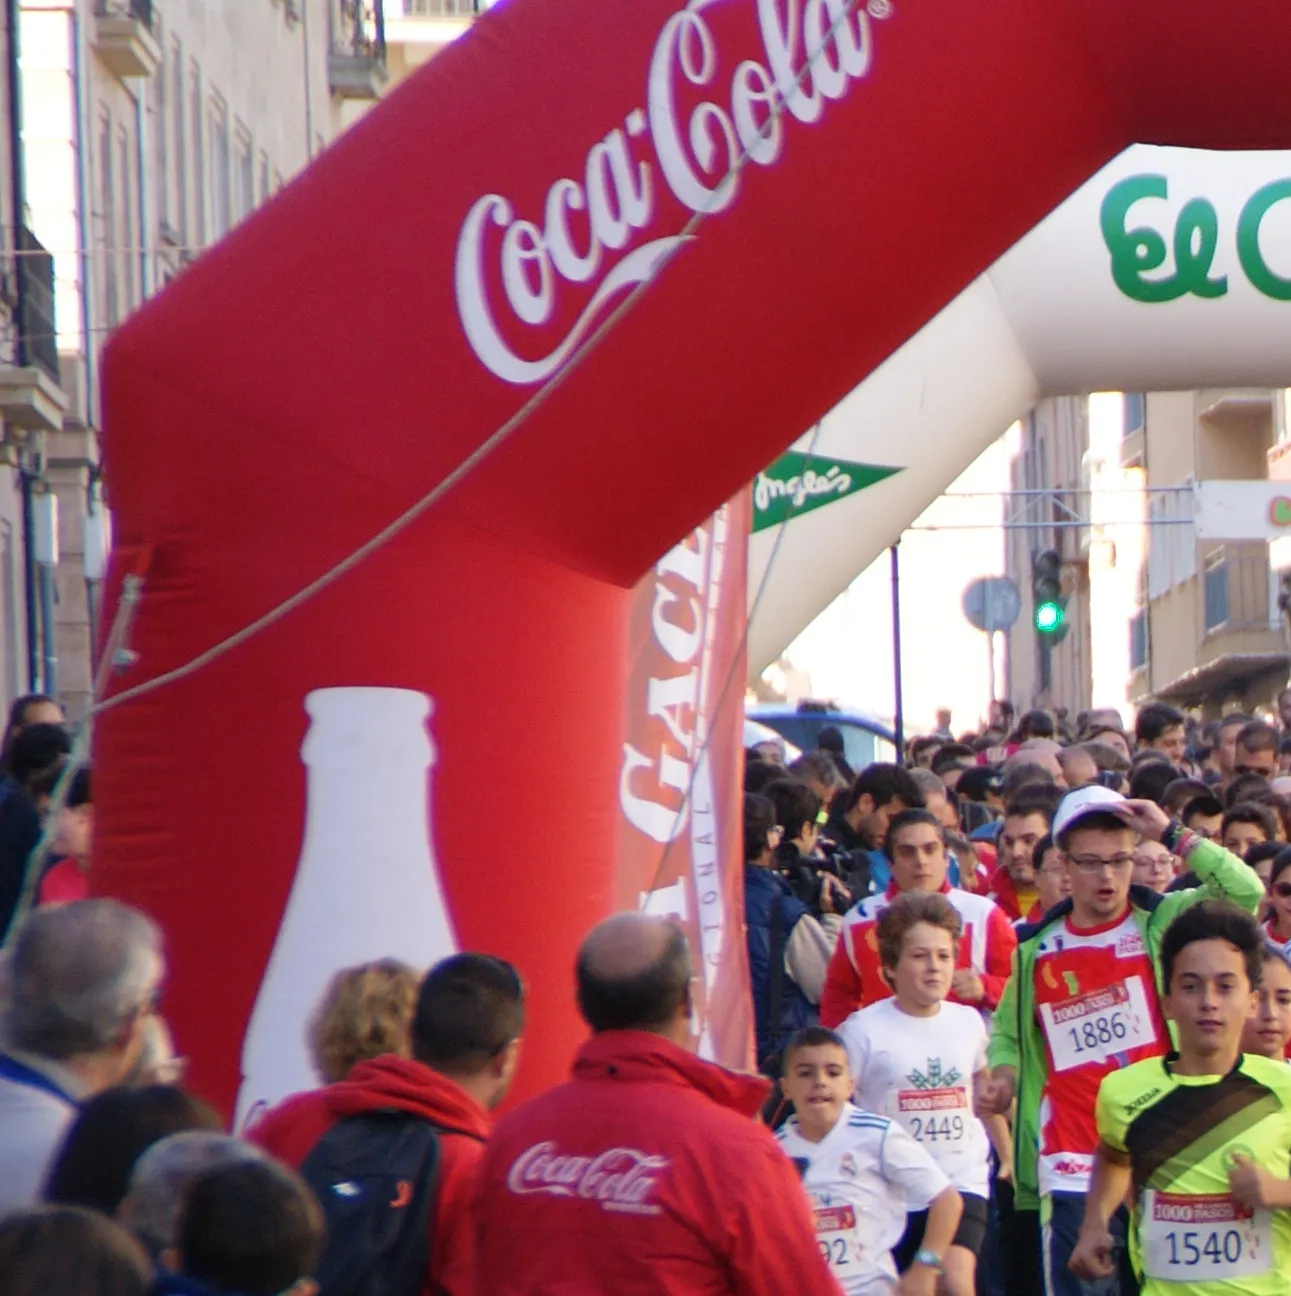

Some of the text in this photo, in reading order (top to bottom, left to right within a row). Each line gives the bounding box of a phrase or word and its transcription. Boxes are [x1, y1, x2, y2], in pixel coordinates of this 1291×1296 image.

[1100, 173, 1227, 304] El
[754, 465, 852, 511] Inglés
[1068, 1011, 1126, 1053] 1886
[909, 1115, 964, 1142] 2449
[1153, 1203, 1193, 1221] 1000
[1165, 1229, 1242, 1266] 1540
